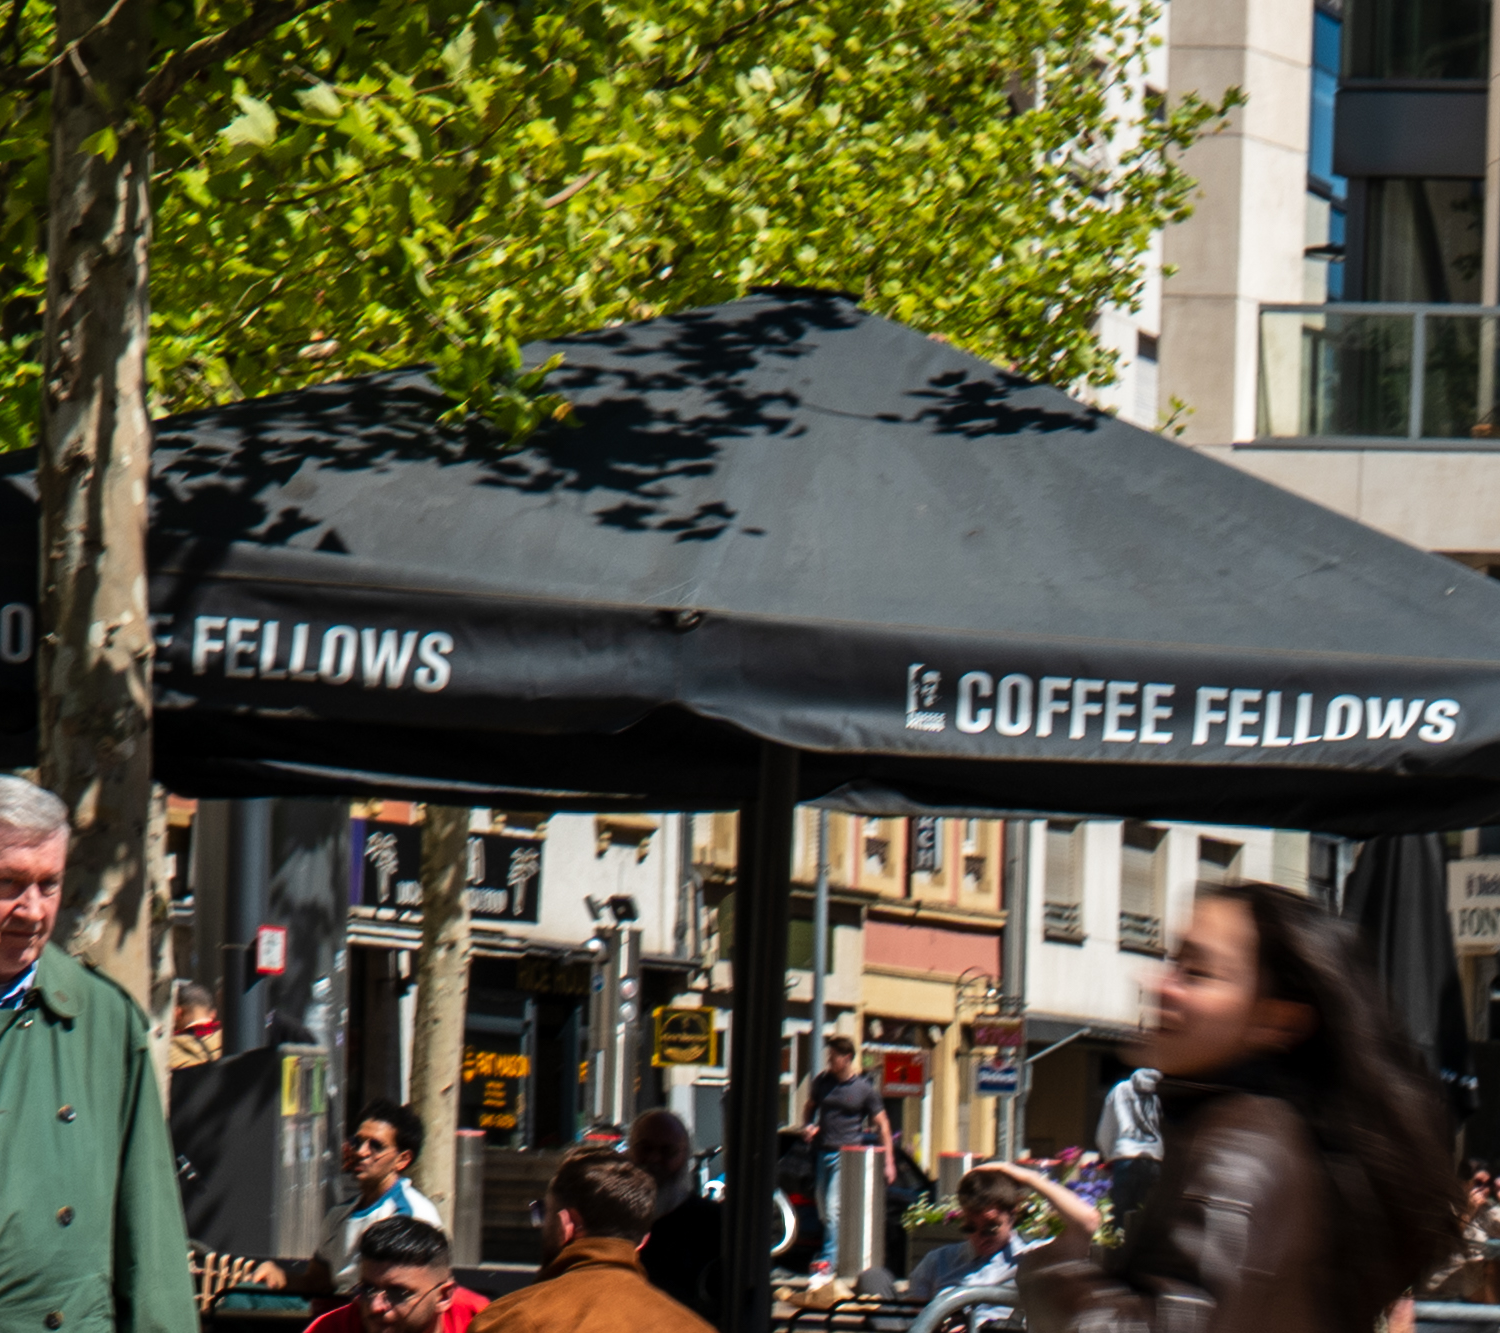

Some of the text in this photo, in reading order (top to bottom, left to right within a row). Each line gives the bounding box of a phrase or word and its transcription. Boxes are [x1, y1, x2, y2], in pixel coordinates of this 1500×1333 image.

[192, 614, 455, 693] FELLOWS
[955, 670, 1461, 748] COFFEE FELLOWS
